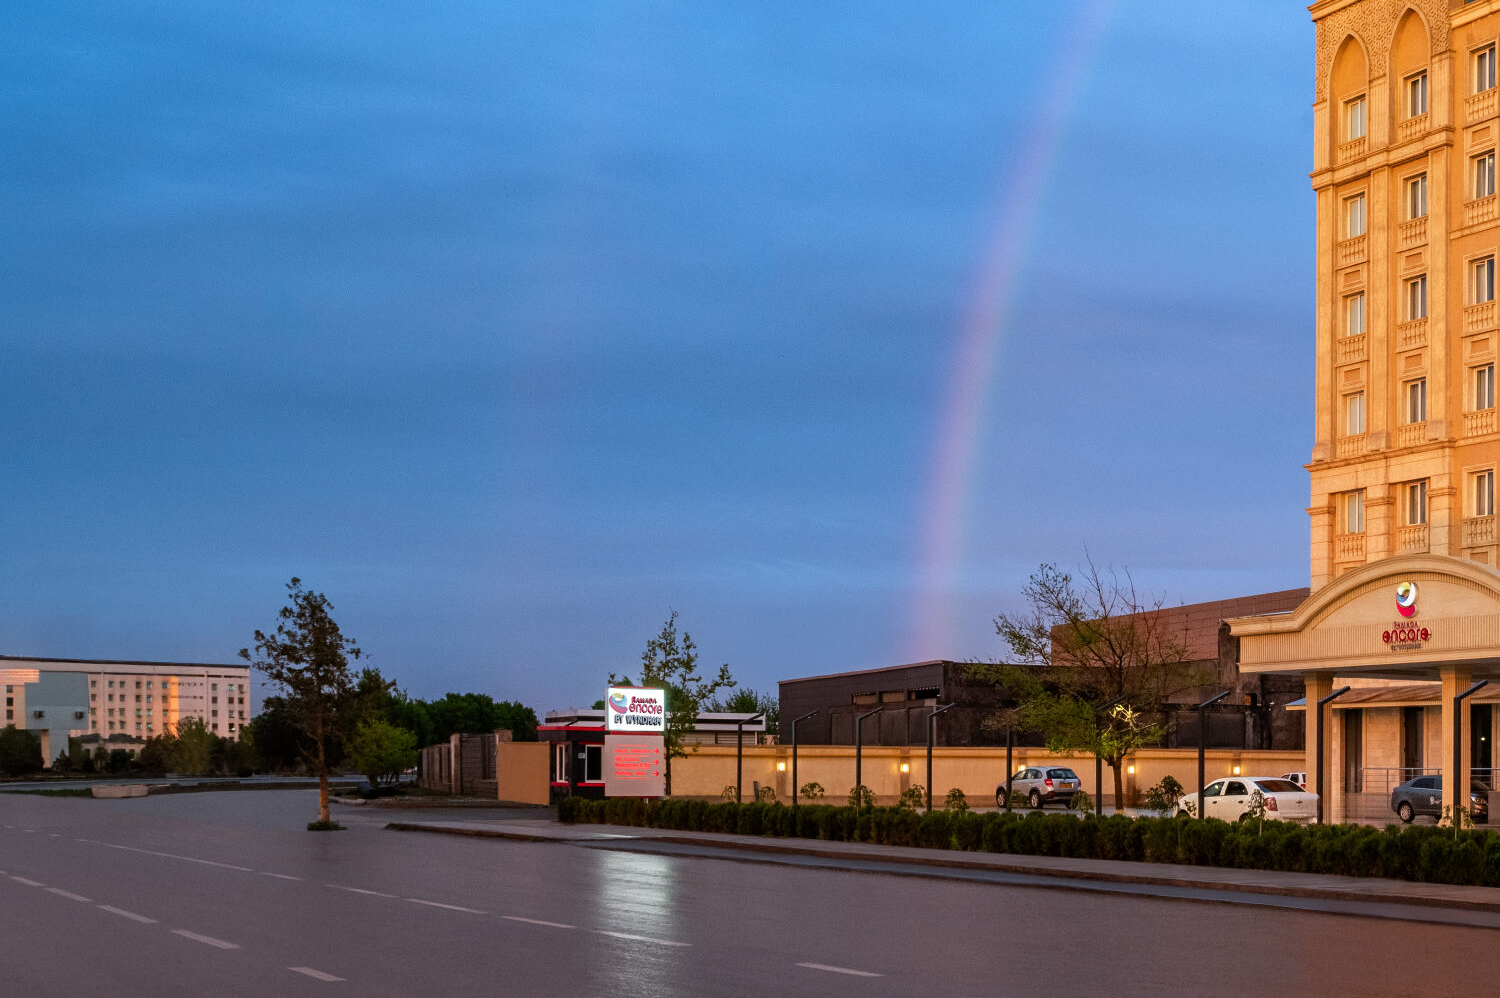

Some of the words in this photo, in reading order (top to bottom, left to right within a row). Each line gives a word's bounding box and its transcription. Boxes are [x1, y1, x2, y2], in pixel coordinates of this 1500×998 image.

[1382, 627, 1429, 643] encore
[629, 704, 662, 714] encore
[614, 715, 624, 724] BY
